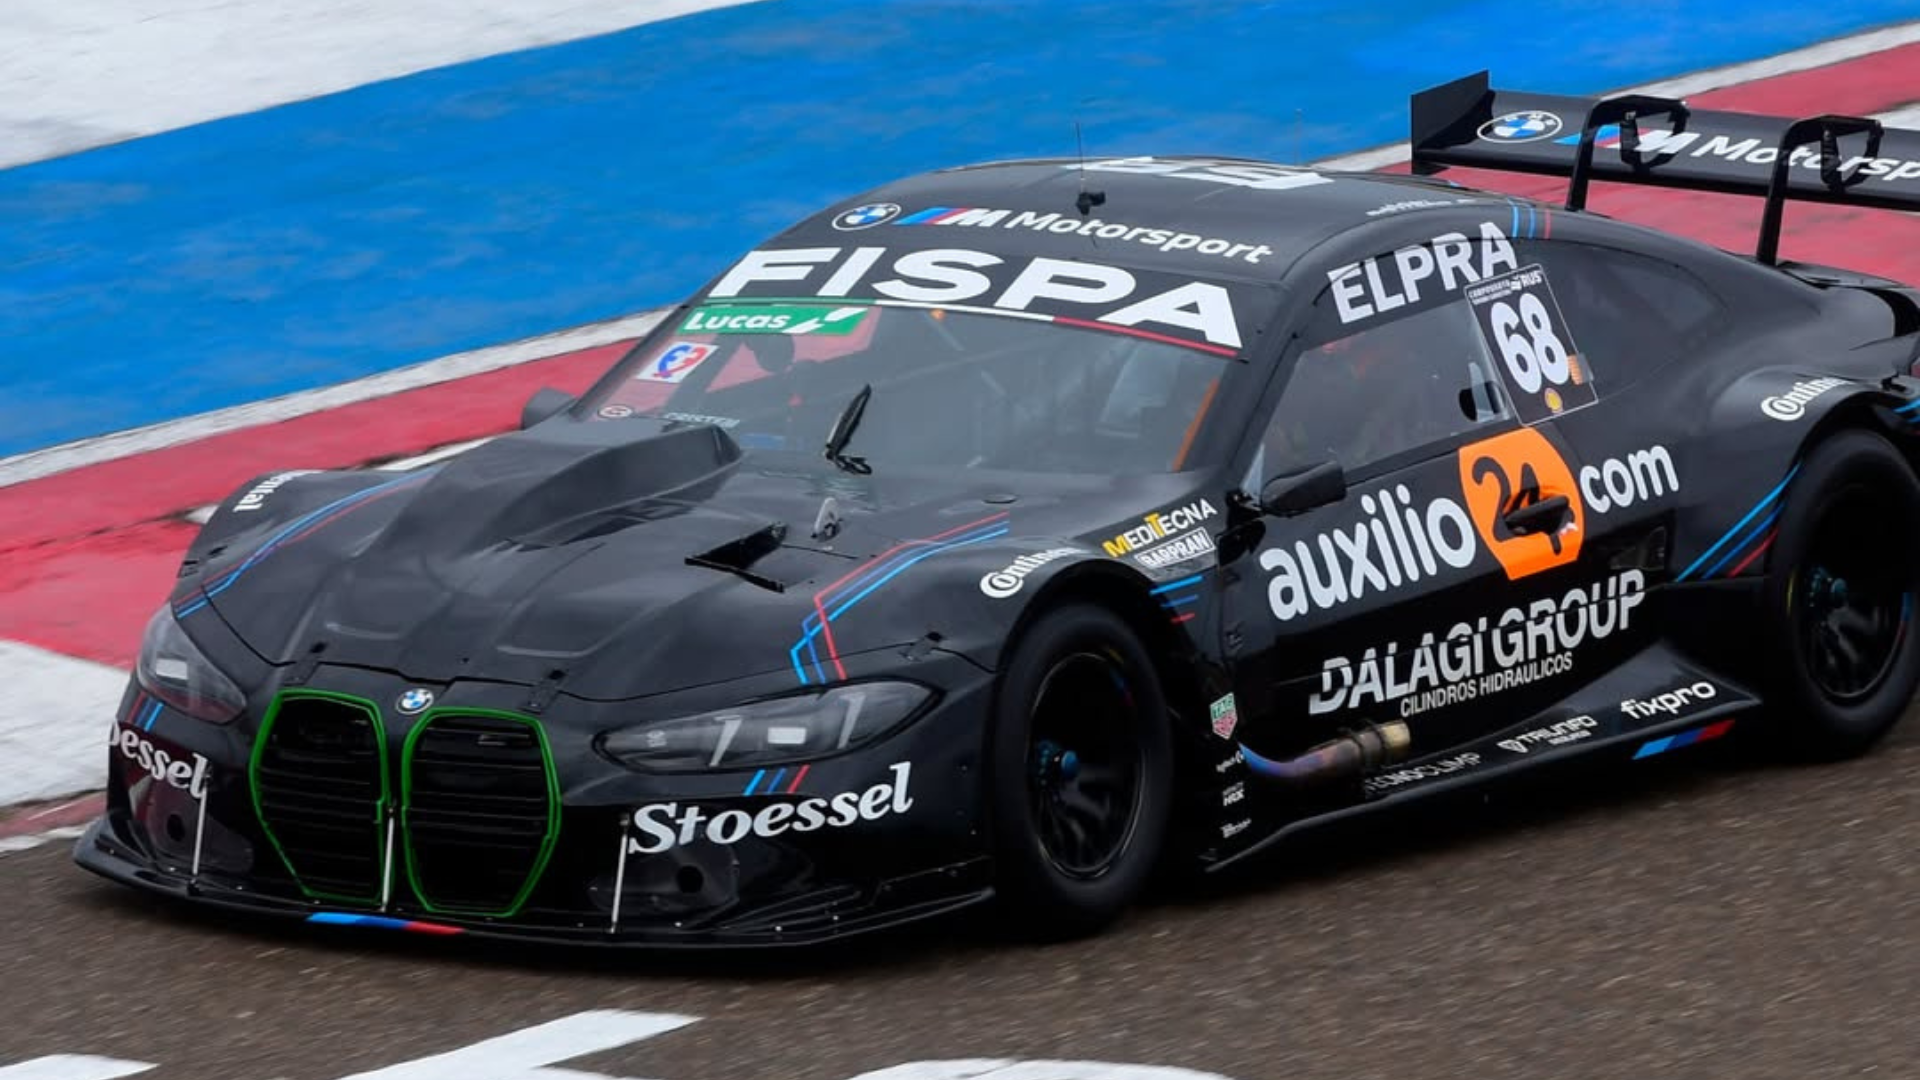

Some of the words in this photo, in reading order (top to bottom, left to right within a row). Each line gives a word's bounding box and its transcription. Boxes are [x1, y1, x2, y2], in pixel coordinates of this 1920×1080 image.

[1003, 210, 1273, 264] Motorsport
[1327, 221, 1518, 324] ELPRA
[684, 311, 792, 331] Lucas
[708, 246, 1242, 349] FISPA
[1490, 292, 1569, 395] 68
[1102, 498, 1219, 558] MEDITECNA
[1260, 484, 1476, 621] auxilio
[1580, 445, 1680, 514] com
[1308, 616, 1487, 716] DALAGI
[1492, 568, 1646, 668] GROUP
[1401, 679, 1477, 718] CILINDROS
[1480, 651, 1573, 696] HIDRAULICOS
[1620, 681, 1717, 720] fixpro
[628, 761, 914, 855] Stoessel
